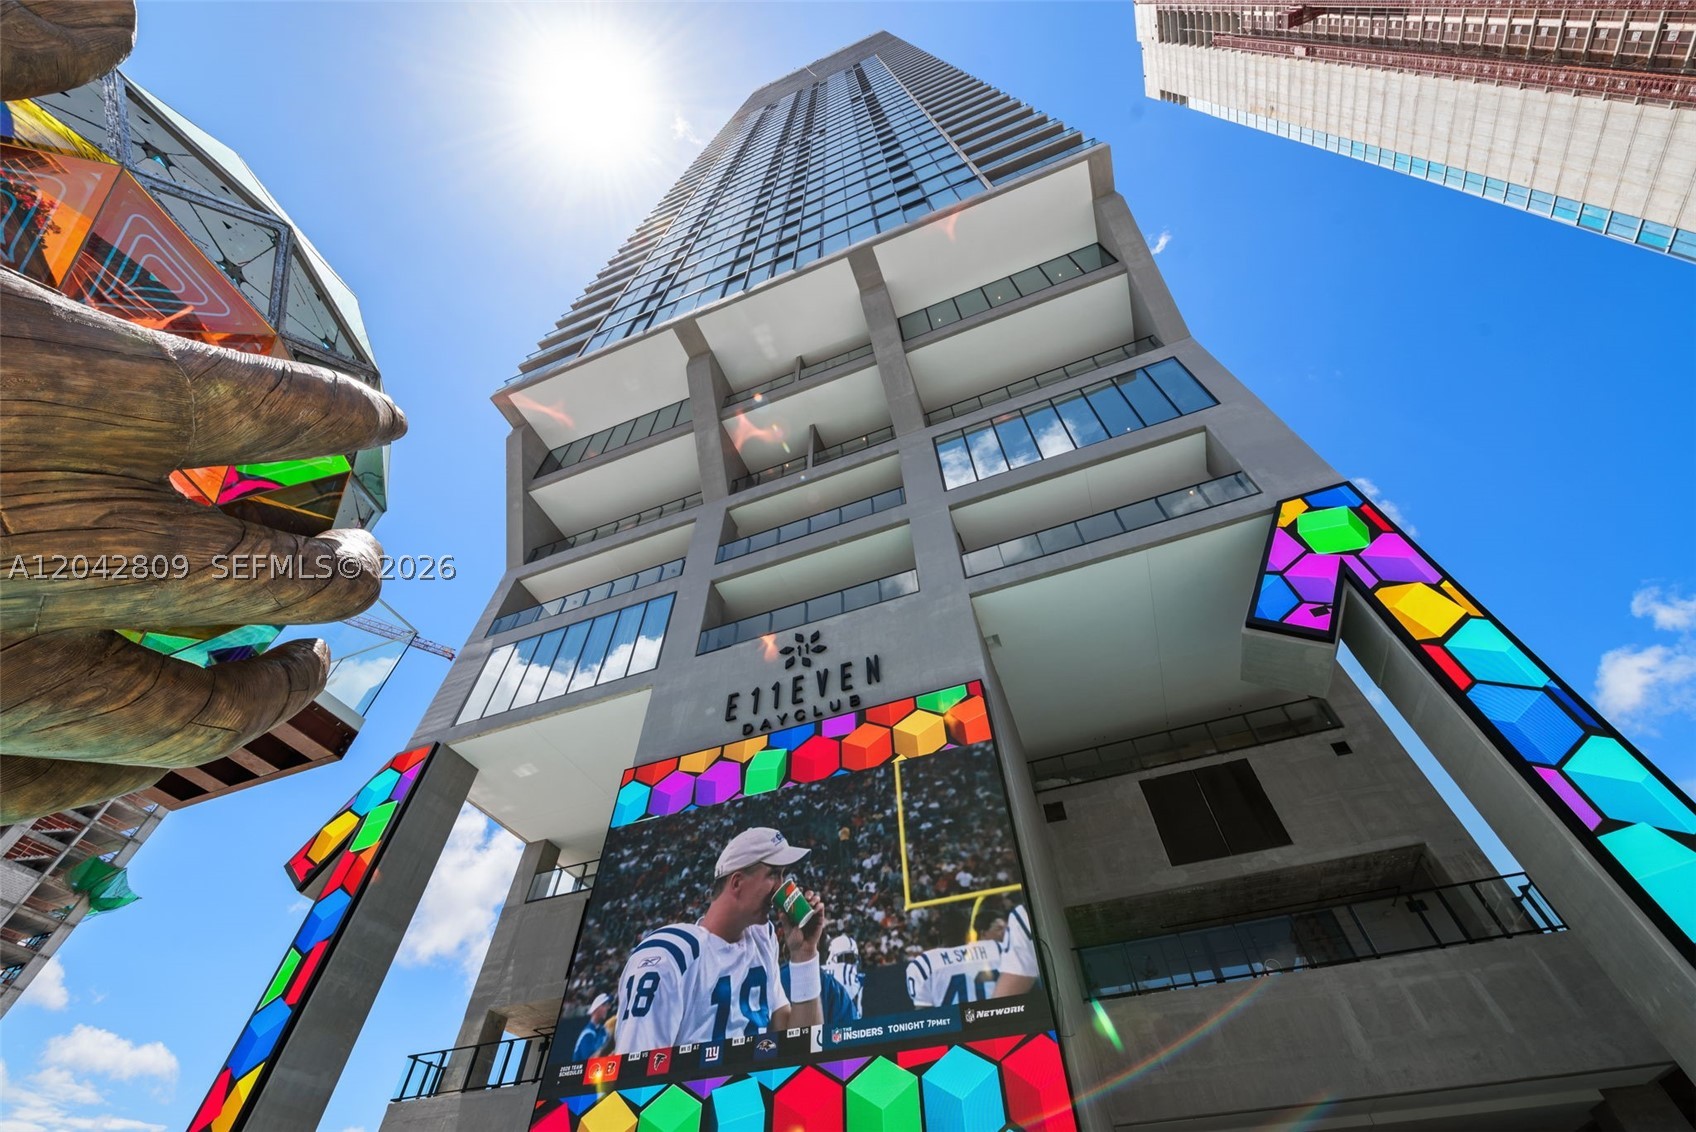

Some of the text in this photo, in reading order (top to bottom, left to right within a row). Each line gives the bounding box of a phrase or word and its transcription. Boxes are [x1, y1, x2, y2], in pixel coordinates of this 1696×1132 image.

[725, 655, 880, 722] E11EVEN
[742, 695, 861, 736] DAYCLUB
[622, 971, 661, 1021] 18
[976, 1005, 1025, 1019] NETWORK
[843, 1027, 884, 1041] INSIDERS
[888, 1020, 925, 1033] TONIGHT
